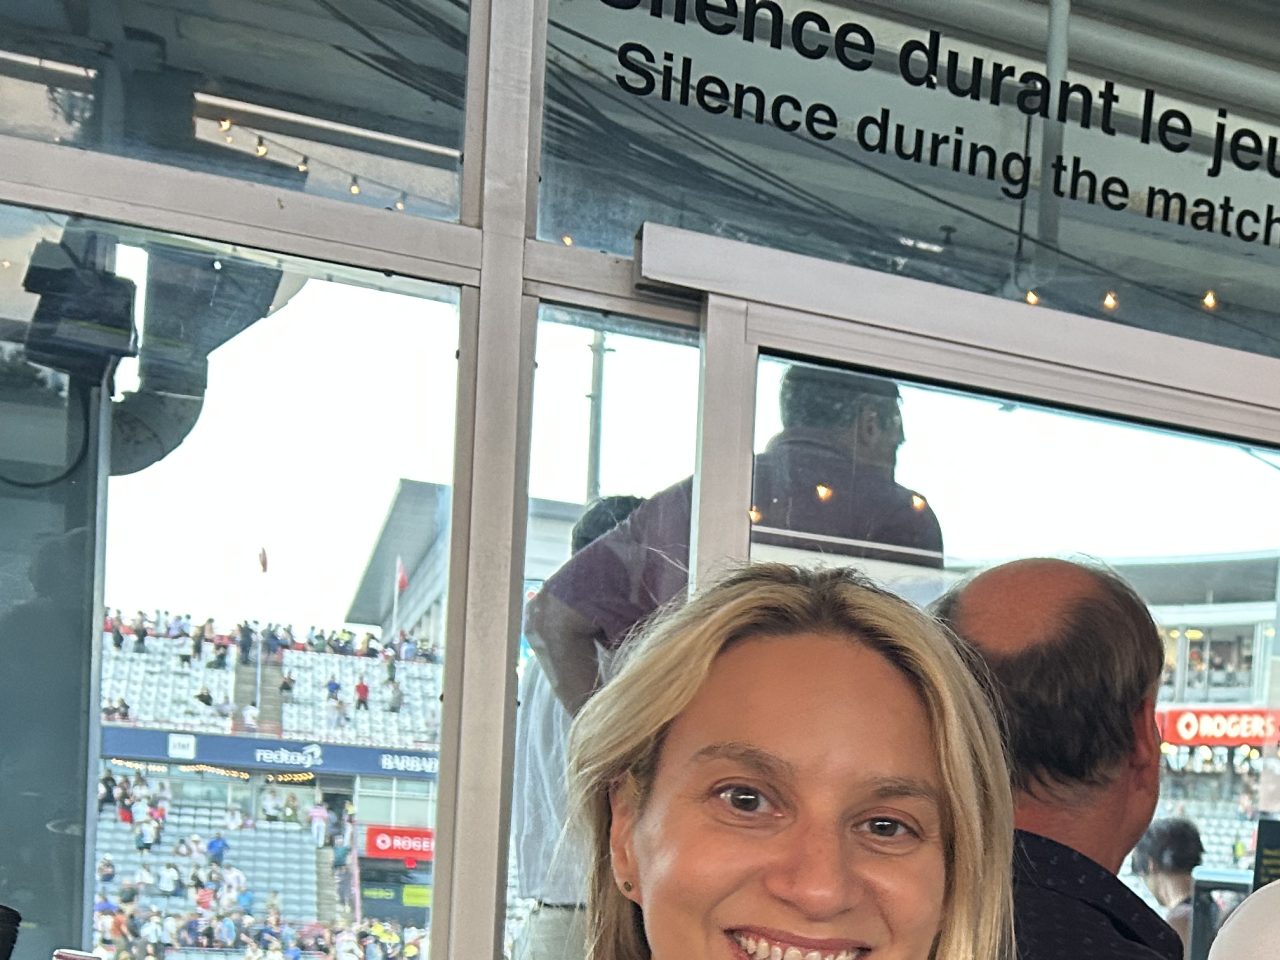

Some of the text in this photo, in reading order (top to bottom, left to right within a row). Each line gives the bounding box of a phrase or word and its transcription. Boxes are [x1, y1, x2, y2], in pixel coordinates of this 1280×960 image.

[600, 0, 875, 71] ence
[899, 30, 1119, 136] durant
[1140, 88, 1192, 153] le
[615, 42, 838, 141] Silence
[856, 107, 1031, 199] during
[1050, 154, 1129, 211] the
[1198, 713, 1277, 739] ROGERS
